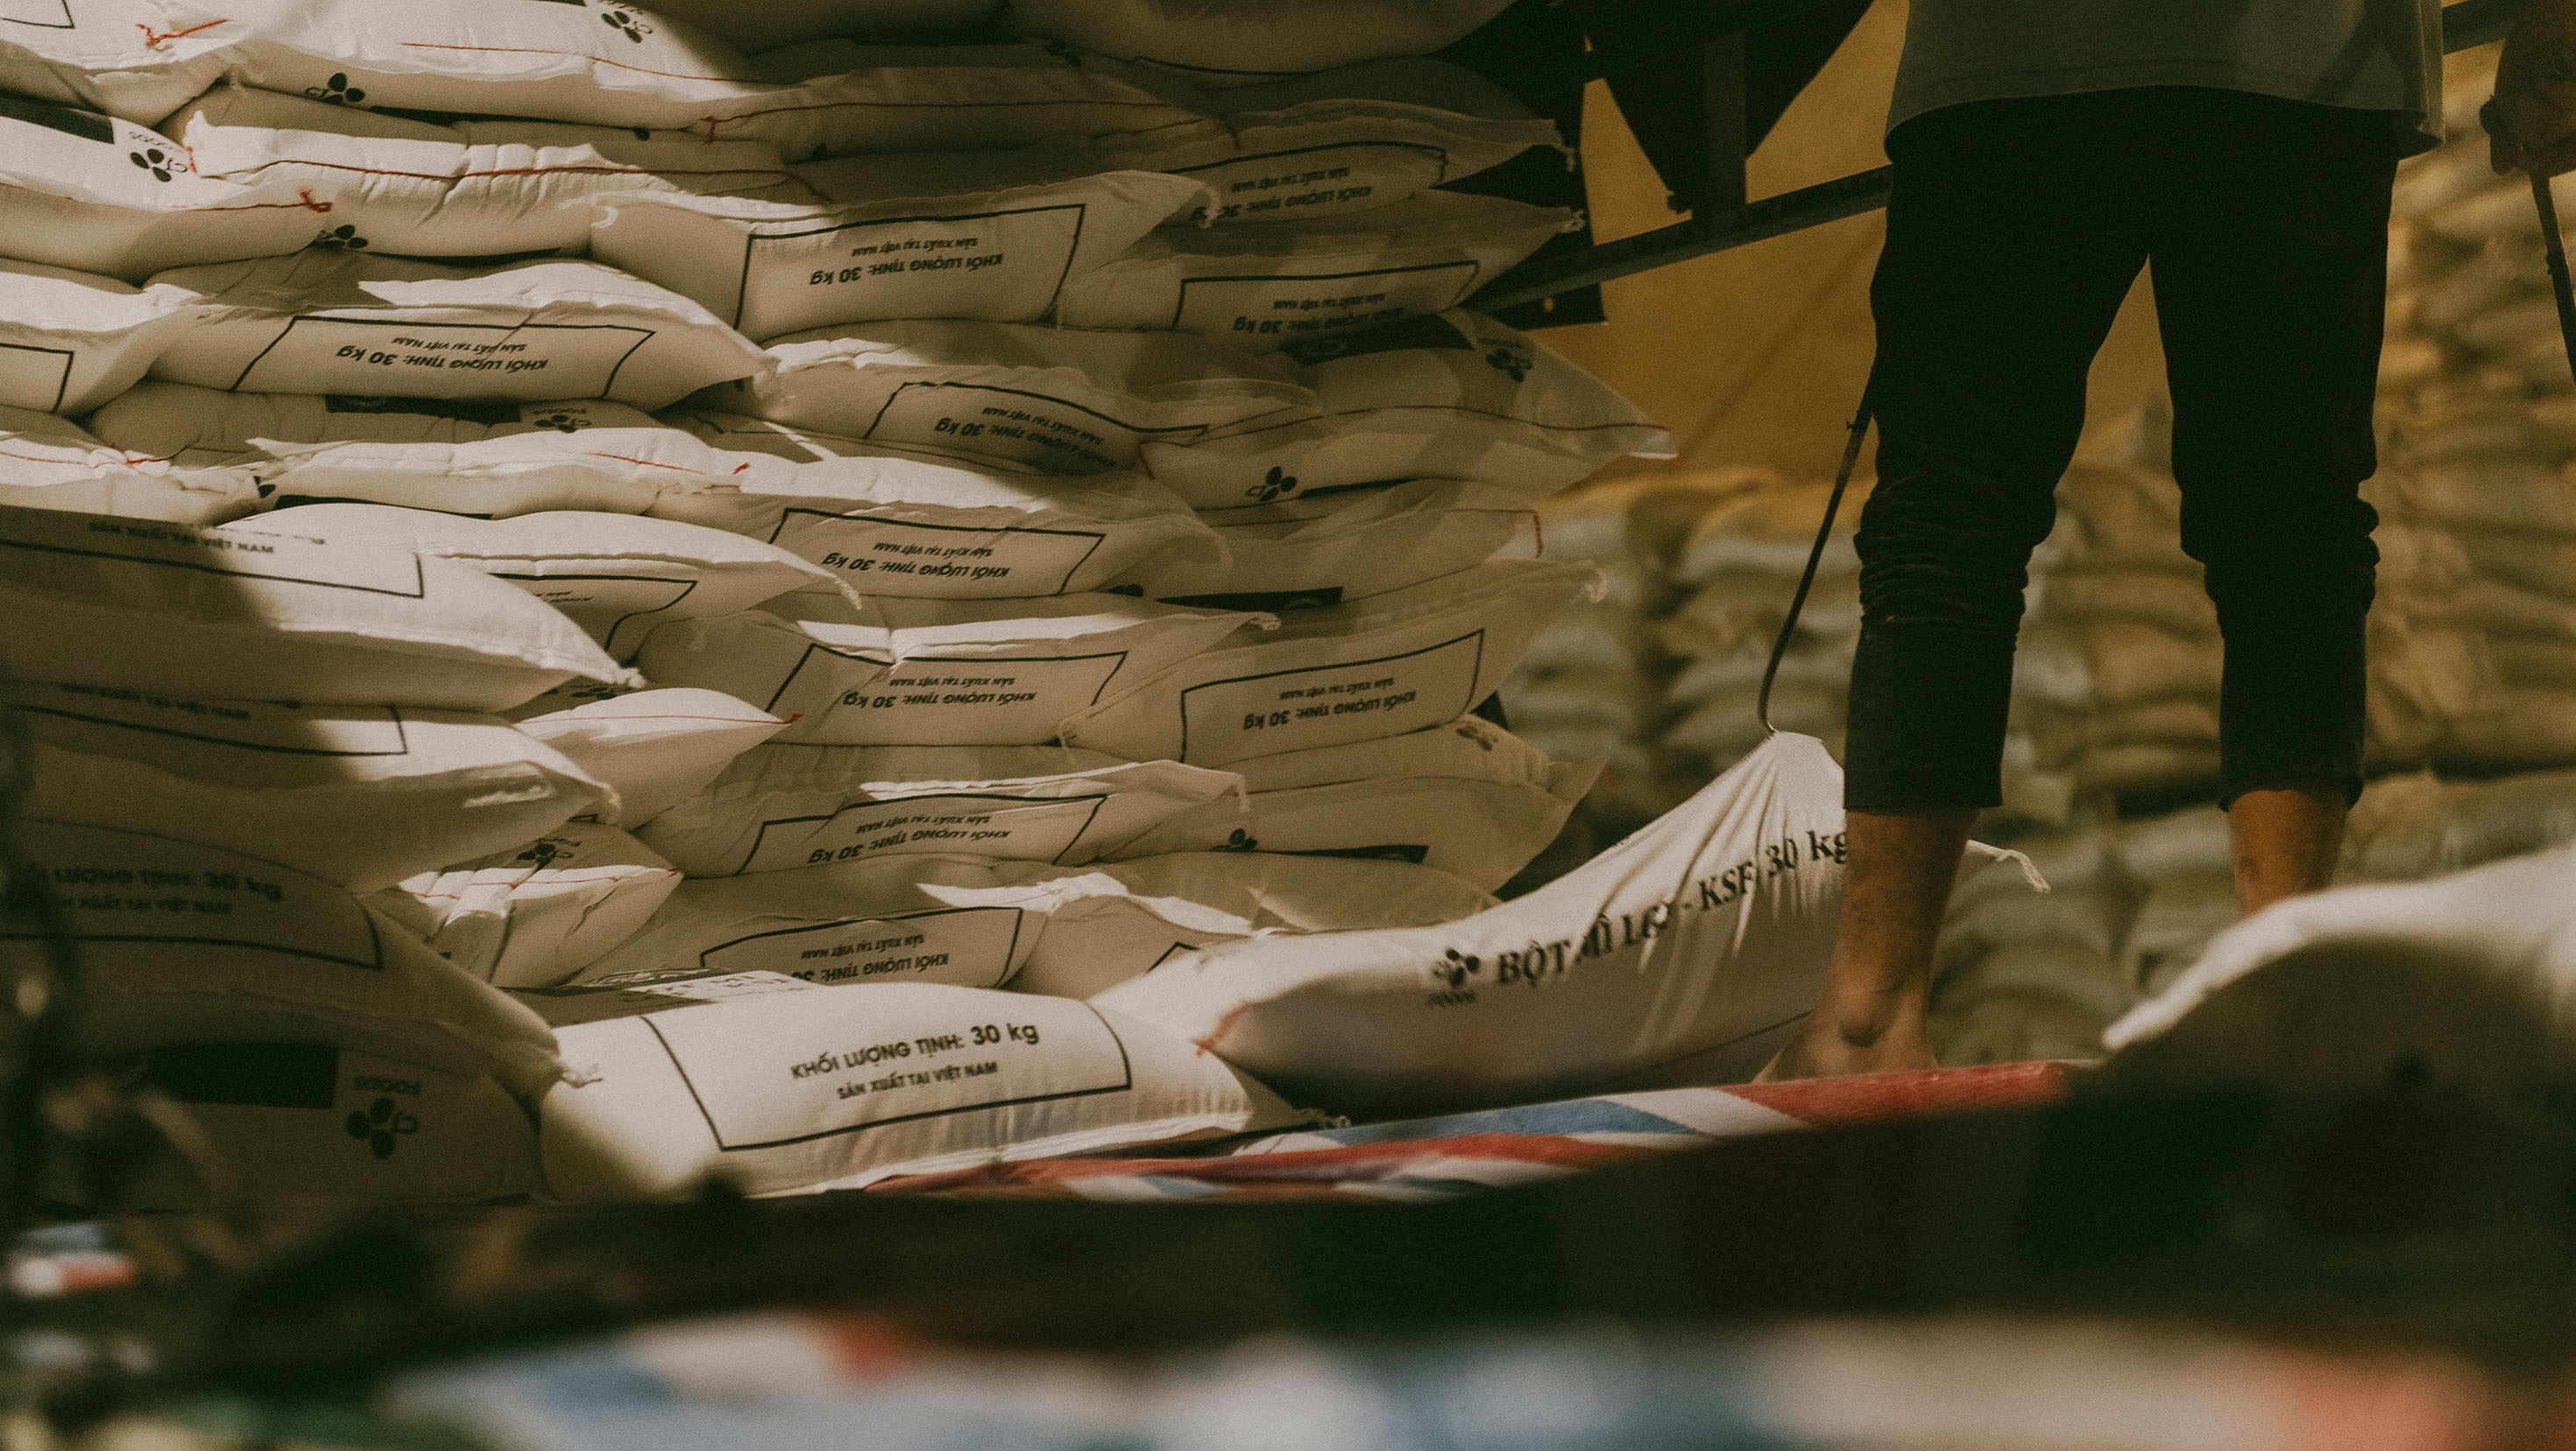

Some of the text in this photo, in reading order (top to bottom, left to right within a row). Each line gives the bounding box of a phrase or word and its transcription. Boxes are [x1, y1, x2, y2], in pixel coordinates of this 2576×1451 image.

[851, 238, 978, 257] SẢN XUẤT TẠI VIỆT NAM
[810, 254, 1002, 287] KHỐI LƯỢNG TỊNH: 30 kg
[1233, 316, 1256, 334] kg
[1260, 321, 1283, 334] 30
[391, 337, 424, 348] NAM
[425, 340, 449, 350] VIỆT
[453, 342, 471, 350] TẠI
[501, 343, 527, 352] SẢN
[335, 346, 548, 373] KHỐI LƯỢNG TỊNH: 30 kg
[202, 534, 233, 550] VIỆT
[237, 541, 276, 555] NAM
[873, 541, 900, 552] NAM
[903, 544, 923, 555] VIỆT
[924, 547, 941, 556] TẠI
[821, 553, 1010, 581] KHỐI LƯỢNG TỊNH: 30 kg
[888, 676, 1016, 688] SẢN XUẤT TẠI VIỆT NAM
[841, 691, 1037, 708] KHỐI LƯỢNG TỊNH: 30 kg
[1242, 690, 1416, 730] KHỐI LƯỢNG TỊNH: 30 kg
[855, 814, 992, 834] SẢN XUẤT TẠI VIỆT NAM
[806, 829, 1010, 864] KHỐI LƯỢNG TỊNH: 30 kg
[204, 871, 239, 890] 30
[246, 877, 283, 902] kg
[1495, 939, 1572, 987] BỘT
[1697, 860, 1755, 910] KSF
[1765, 839, 1800, 878] 30
[801, 934, 924, 959] SẢN XUẤT TẠI VIỆT NAM
[820, 962, 859, 981] TỊNH:
[862, 957, 912, 975] LƯỢNG
[916, 953, 949, 973] KHỐI
[790, 1023, 1040, 1079] KHỐI LƯỢNG TỊNH: 30 kg
[837, 1062, 998, 1100] SẢN XUẤT TẠI VIỆT NAM
